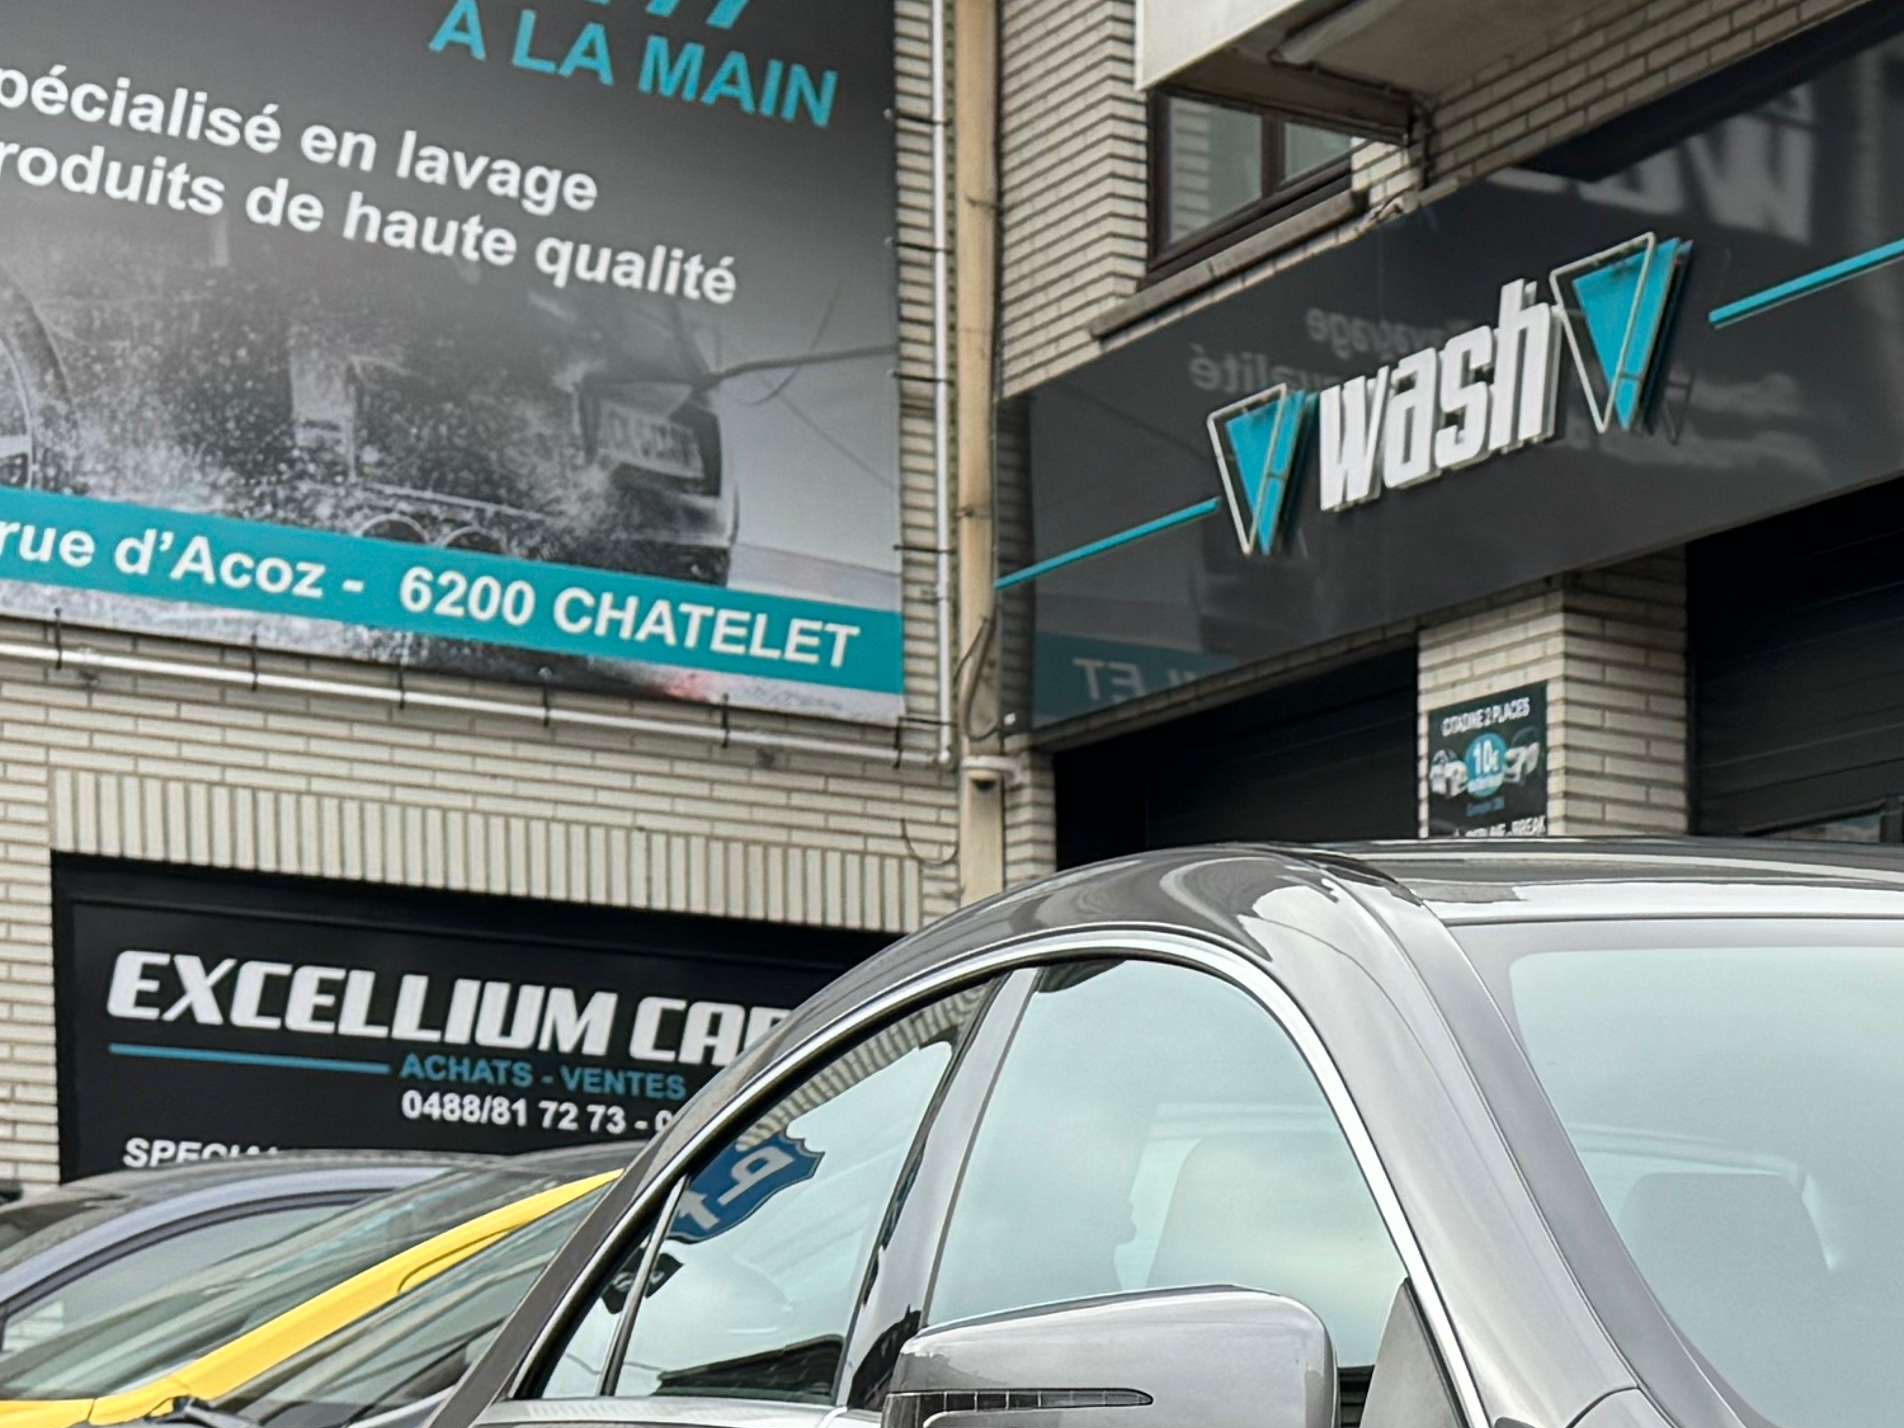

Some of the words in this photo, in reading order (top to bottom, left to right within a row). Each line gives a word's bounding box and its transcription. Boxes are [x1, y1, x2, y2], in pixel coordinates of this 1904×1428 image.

[512, 10, 614, 86] LA
[639, 35, 838, 128] MAIN
[301, 123, 377, 172] en
[397, 130, 597, 216] lavage
[245, 178, 324, 232] de
[343, 191, 516, 266] haute
[535, 235, 736, 304] qualité
[1320, 277, 1562, 514] wash
[400, 566, 536, 627] 6200
[553, 586, 860, 668] CHATELET
[107, 950, 618, 1057] EXCELLIUM
[401, 1053, 533, 1087] ACHATS
[561, 1067, 686, 1099] VENTES
[402, 1090, 527, 1127] 0488/81
[539, 1101, 578, 1131] 72
[588, 1104, 626, 1134] 73
